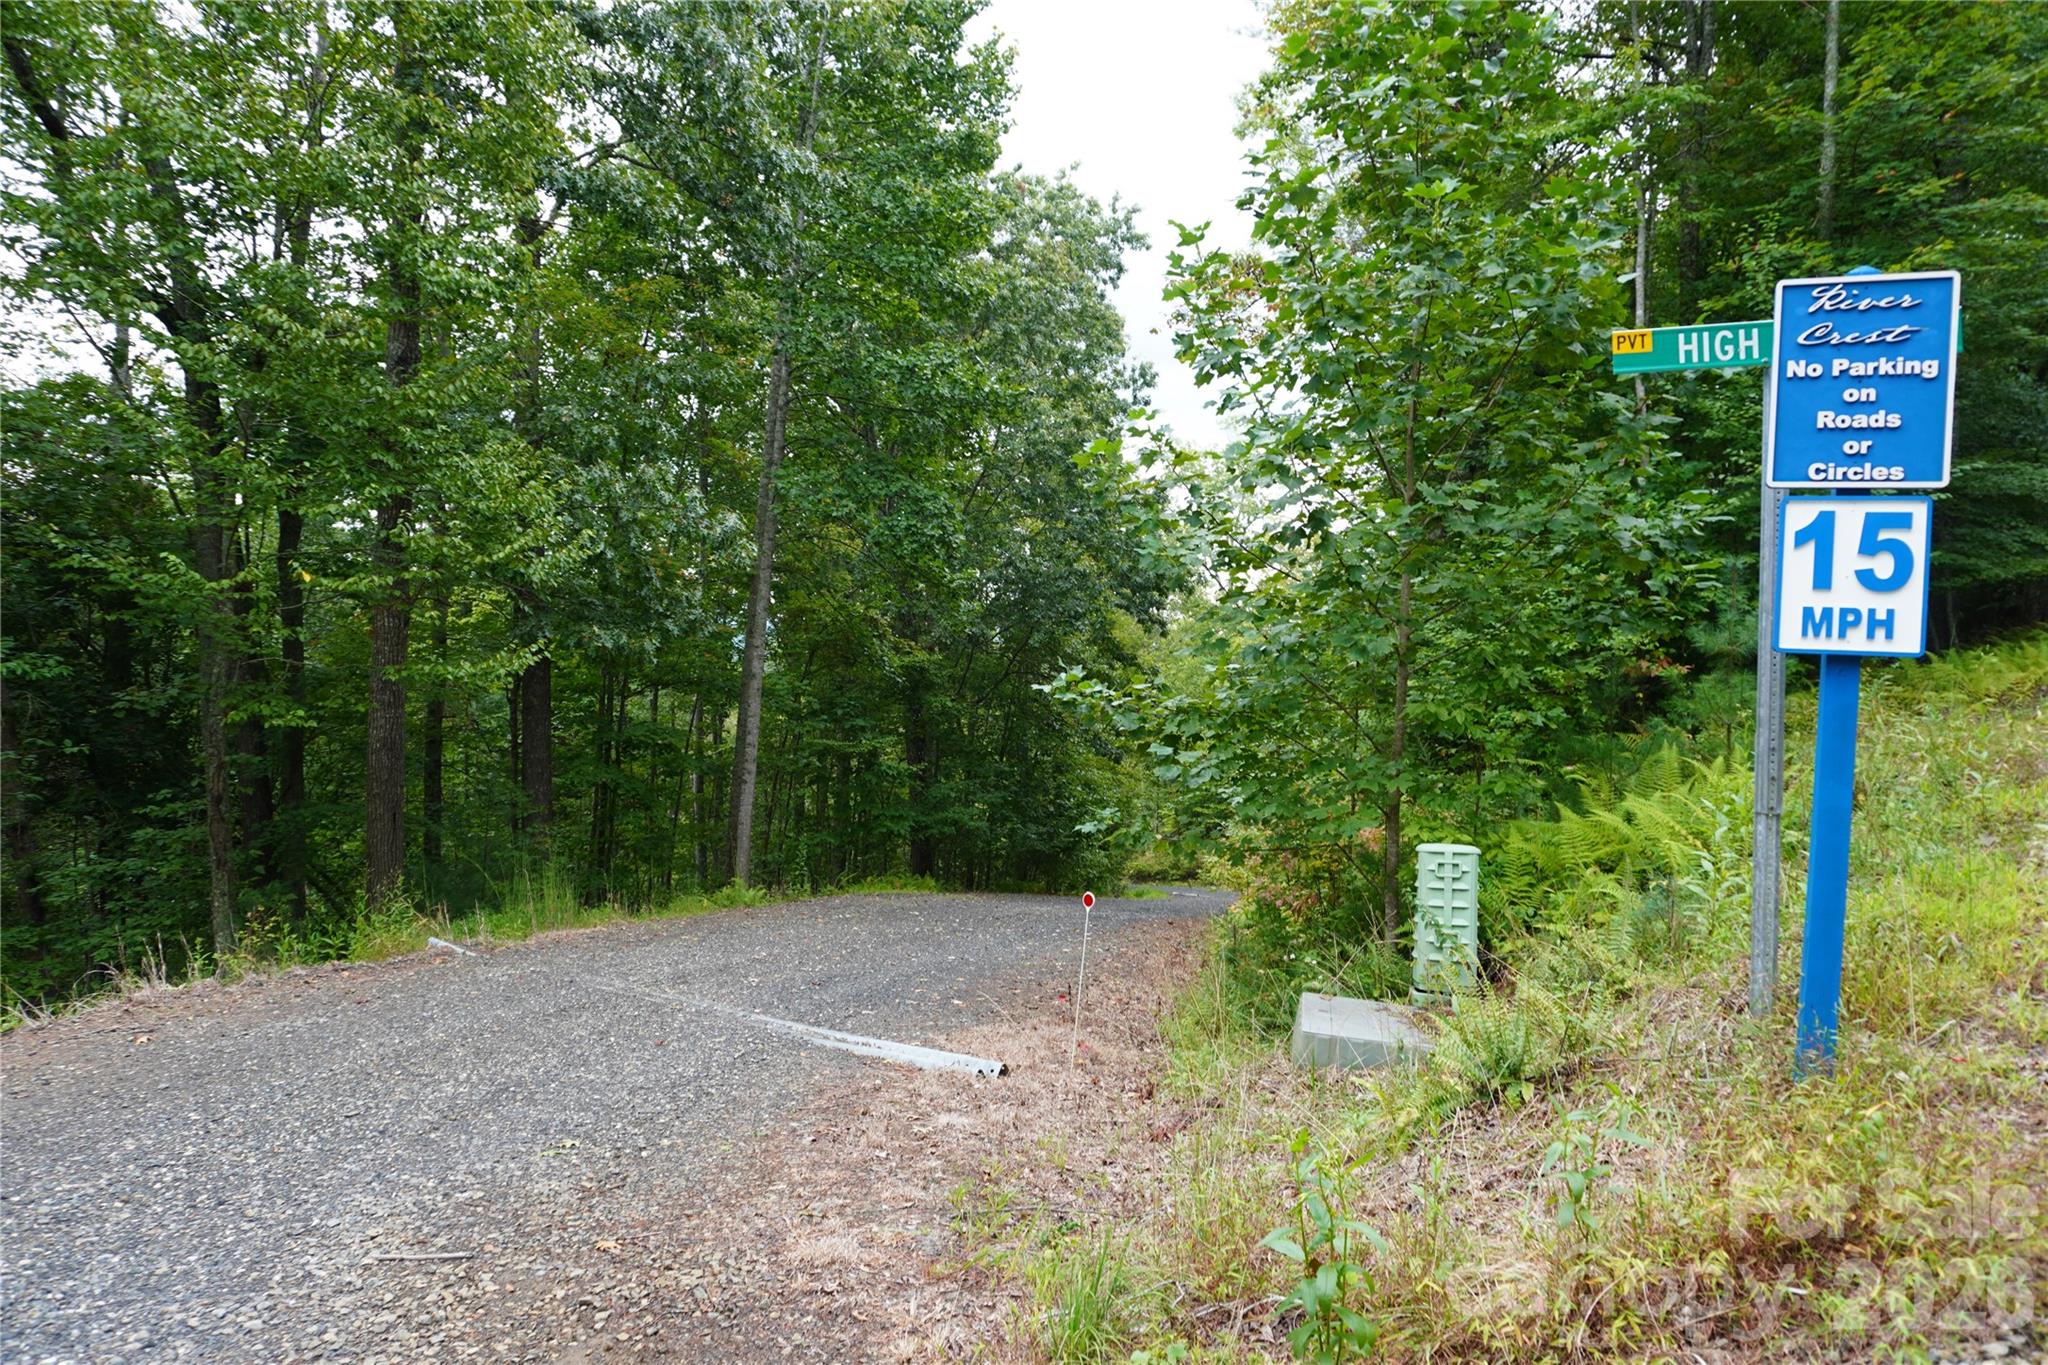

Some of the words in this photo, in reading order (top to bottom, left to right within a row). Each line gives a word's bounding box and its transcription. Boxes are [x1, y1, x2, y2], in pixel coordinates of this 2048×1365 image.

[1807, 283, 1922, 313] River
[1616, 333, 1648, 352] PVT
[1796, 323, 1922, 345] Crest
[1678, 328, 1760, 364] HIGH
[1786, 360, 1824, 379] No
[1832, 357, 1939, 379] Parking
[1842, 387, 1877, 402] on
[1816, 410, 1902, 429] Roads
[1842, 439, 1872, 455] or
[1807, 462, 1905, 482] Circles
[1793, 510, 1915, 593] 15
[1801, 606, 1895, 641] MPH
